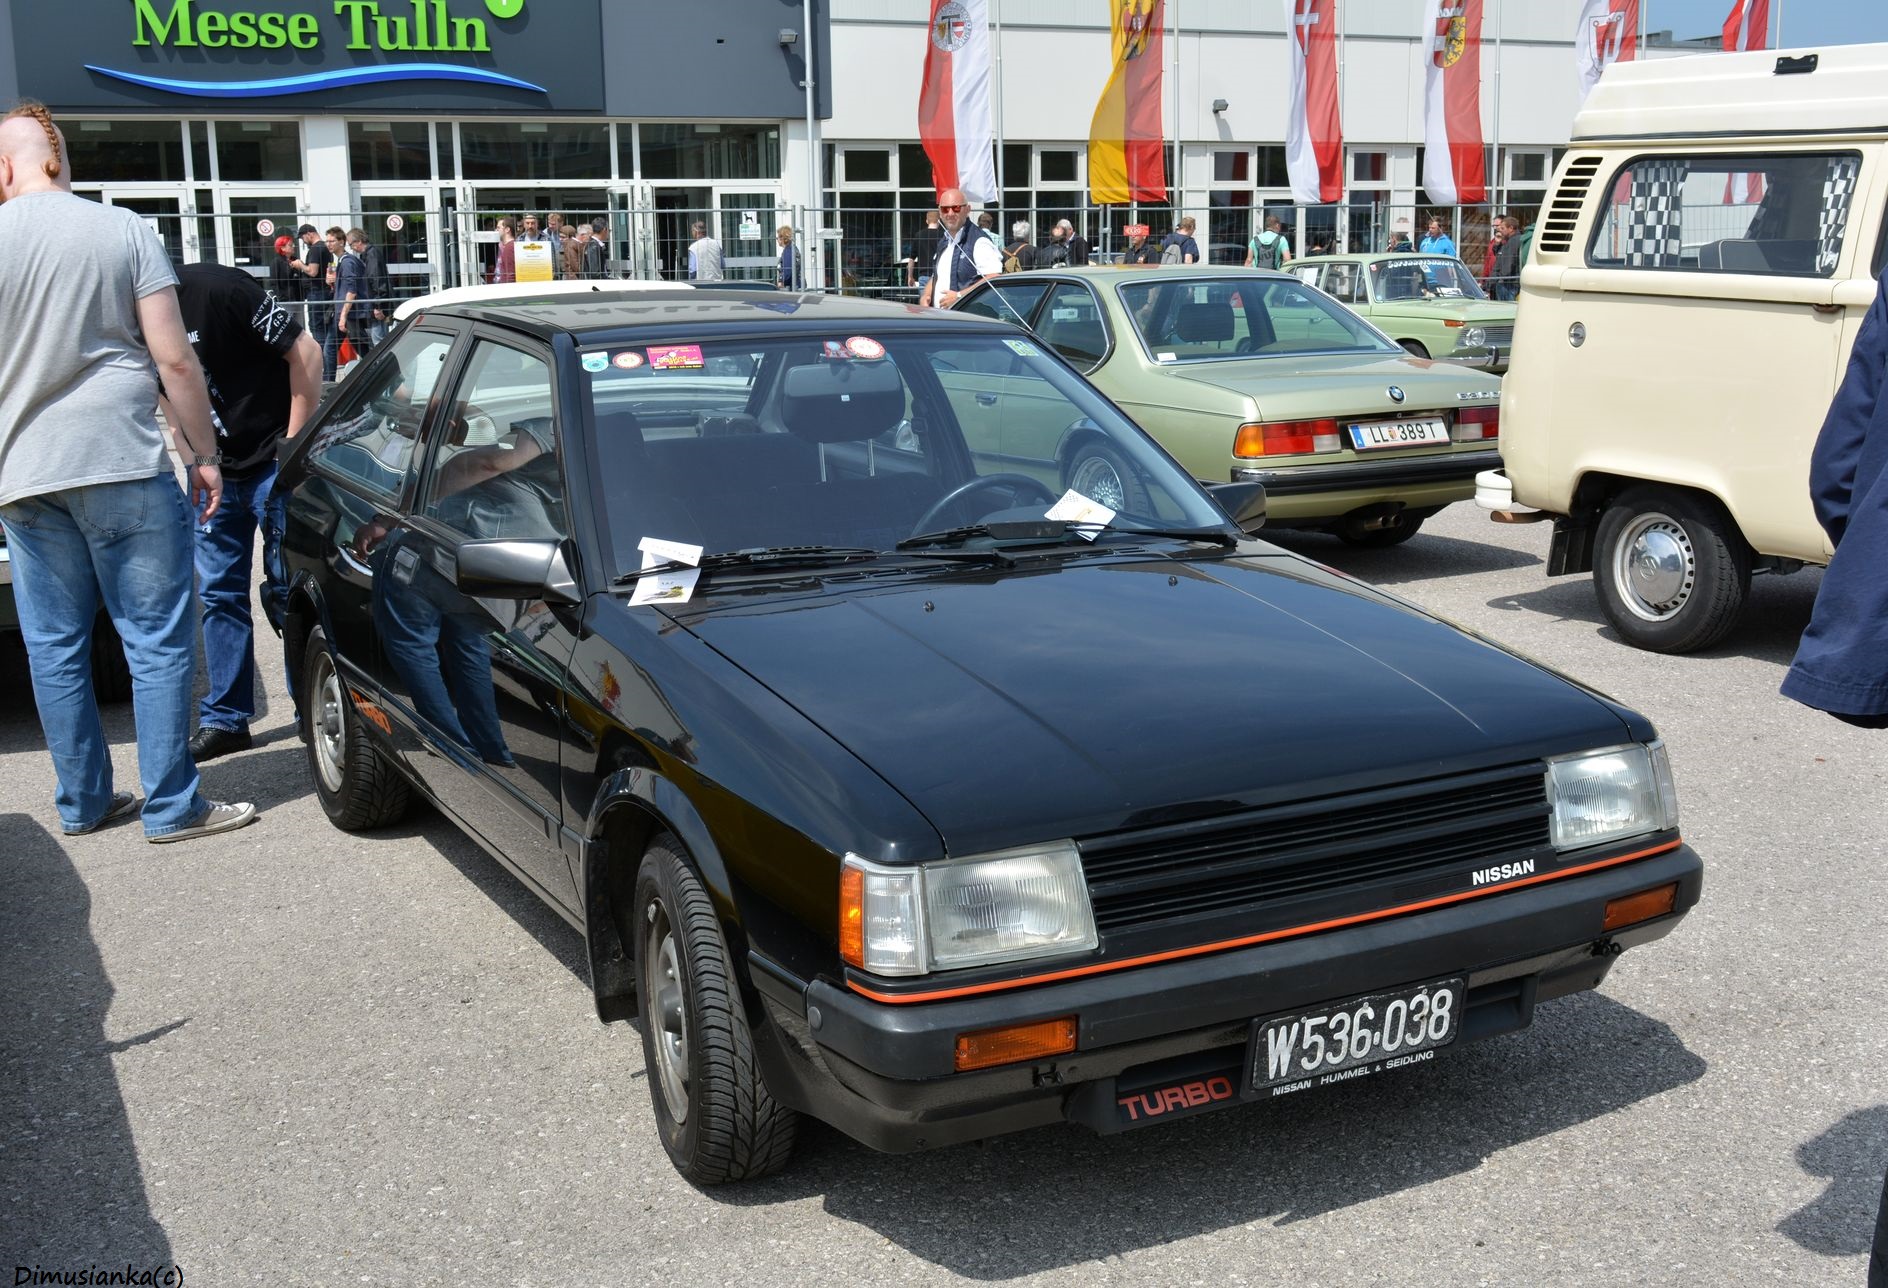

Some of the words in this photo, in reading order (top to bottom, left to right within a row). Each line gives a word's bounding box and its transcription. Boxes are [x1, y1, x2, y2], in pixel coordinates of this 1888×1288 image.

[132, 0, 318, 49] Messe
[334, 0, 491, 52] Tulln
[1472, 859, 1535, 886] NISSAN
[1272, 1079, 1312, 1096] NISSAN
[1320, 1066, 1371, 1085] HUMMEL
[1374, 1064, 1382, 1072] &
[1386, 1050, 1434, 1069] SEIDLING
[1118, 1076, 1233, 1120] TURBO
